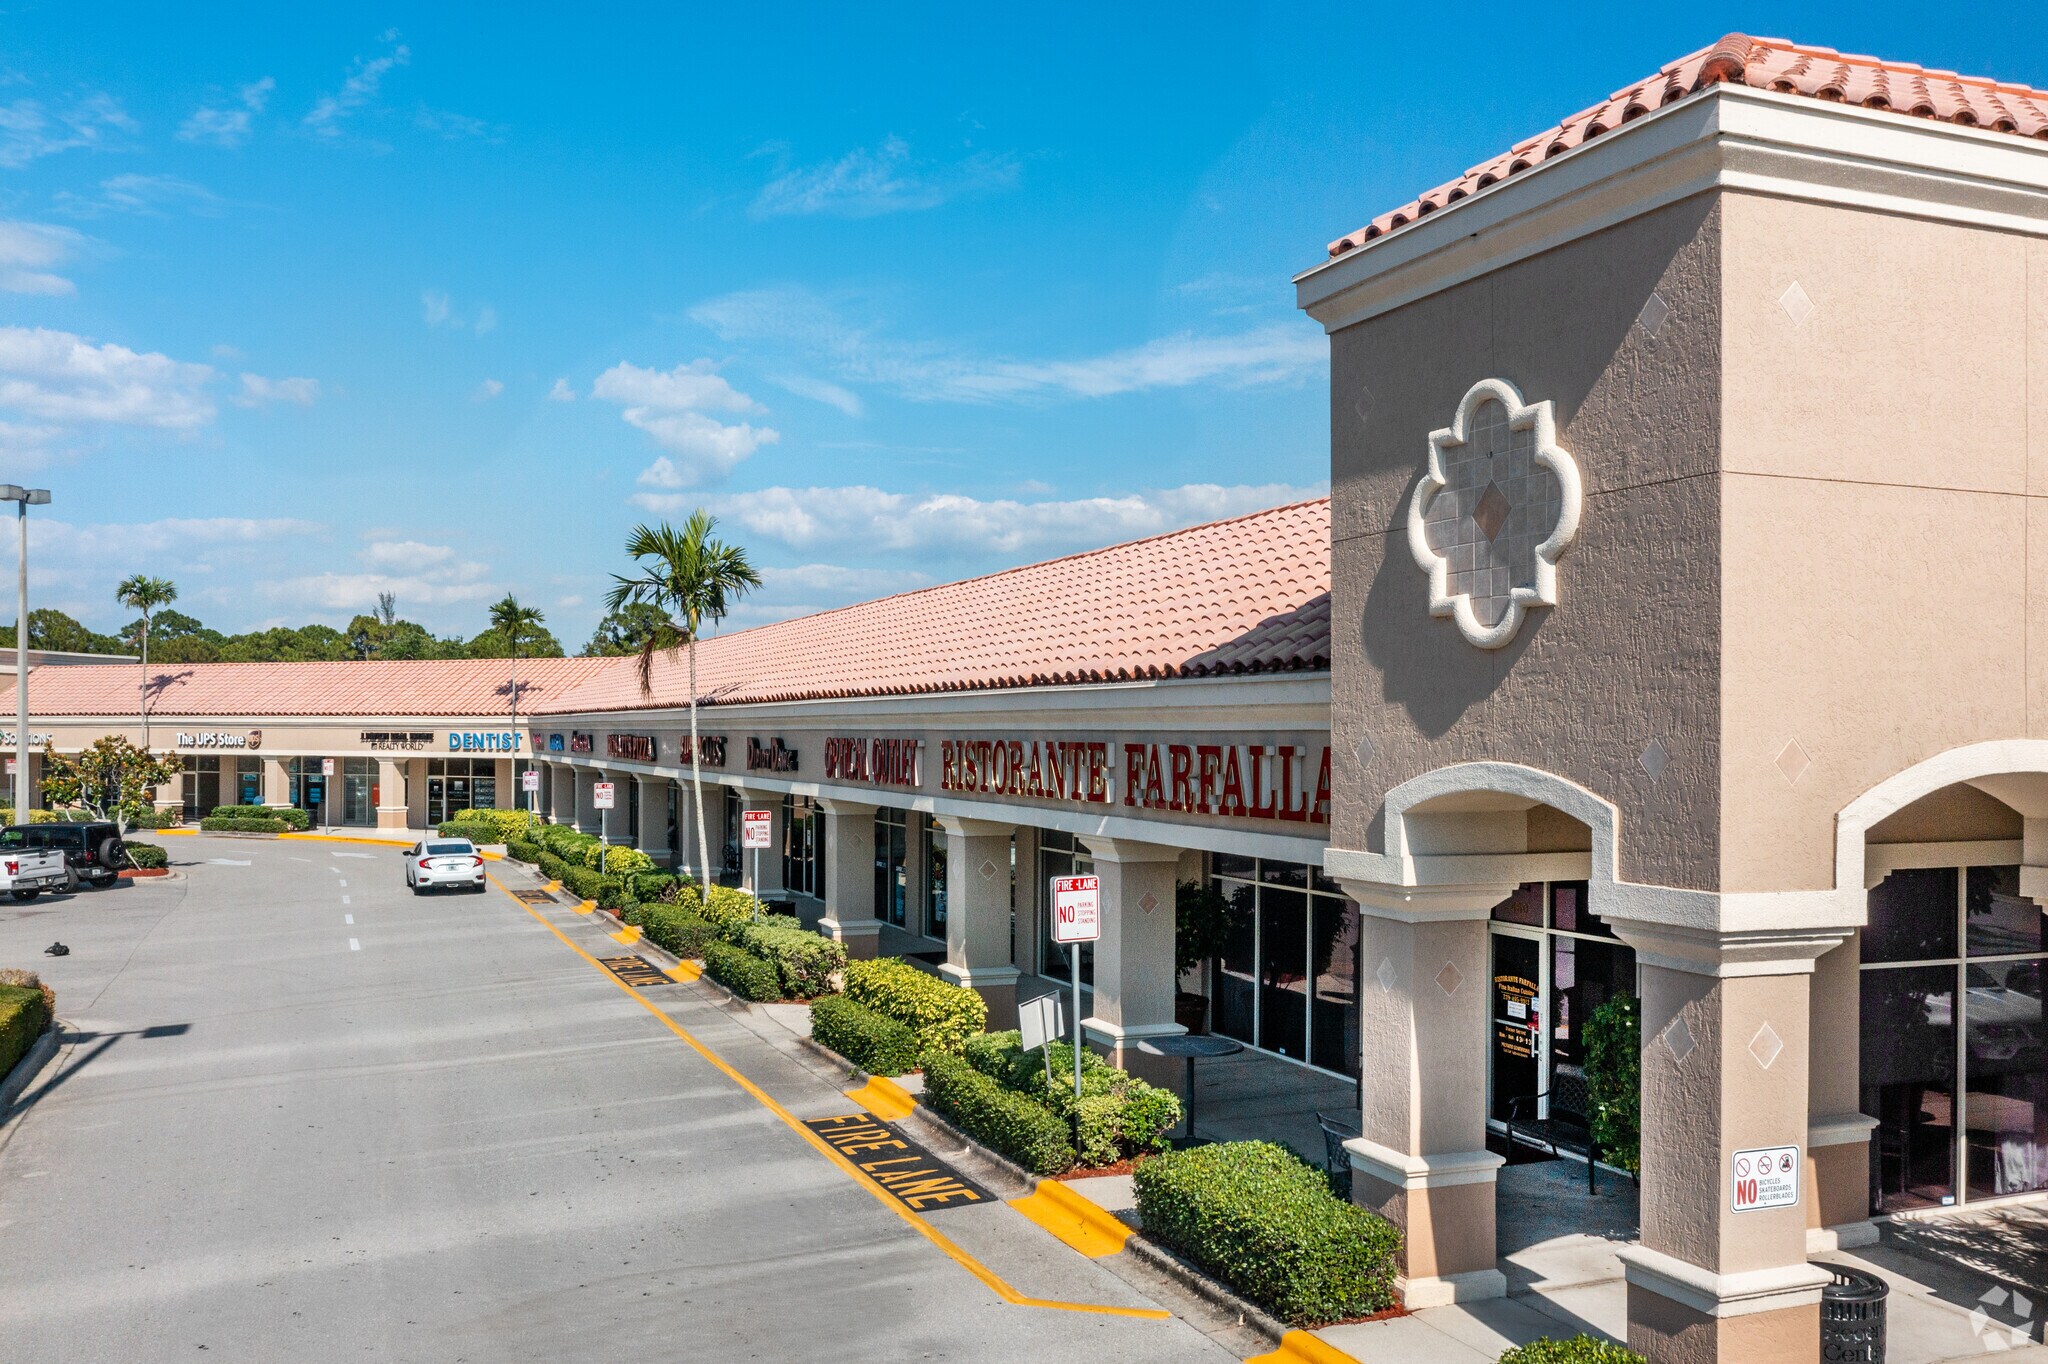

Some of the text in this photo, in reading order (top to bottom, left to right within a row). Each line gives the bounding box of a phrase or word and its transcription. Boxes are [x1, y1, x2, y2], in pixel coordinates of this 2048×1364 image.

[176, 732, 246, 746] The UPS Store
[449, 732, 522, 750] DENTIST
[378, 742, 424, 751] REALTY WORLD
[824, 736, 871, 782] OPTICAL
[872, 737, 925, 787] OUTLET
[940, 739, 1116, 804] RISTORANTE
[595, 792, 603, 800] NO
[757, 812, 770, 820] LANE
[745, 827, 755, 841] NO
[1057, 878, 1097, 891] FIRE LANE
[1059, 905, 1075, 924] NO
[1077, 909, 1096, 917] STOPPING
[807, 1113, 981, 1209] FIRE LANE
[1759, 1178, 1781, 1186] BICYCLES
[1736, 1179, 1757, 1205] NO
[1759, 1184, 1792, 1194] SKATEBOARDS
[1759, 1191, 1794, 1201] ROLLERBLADES
